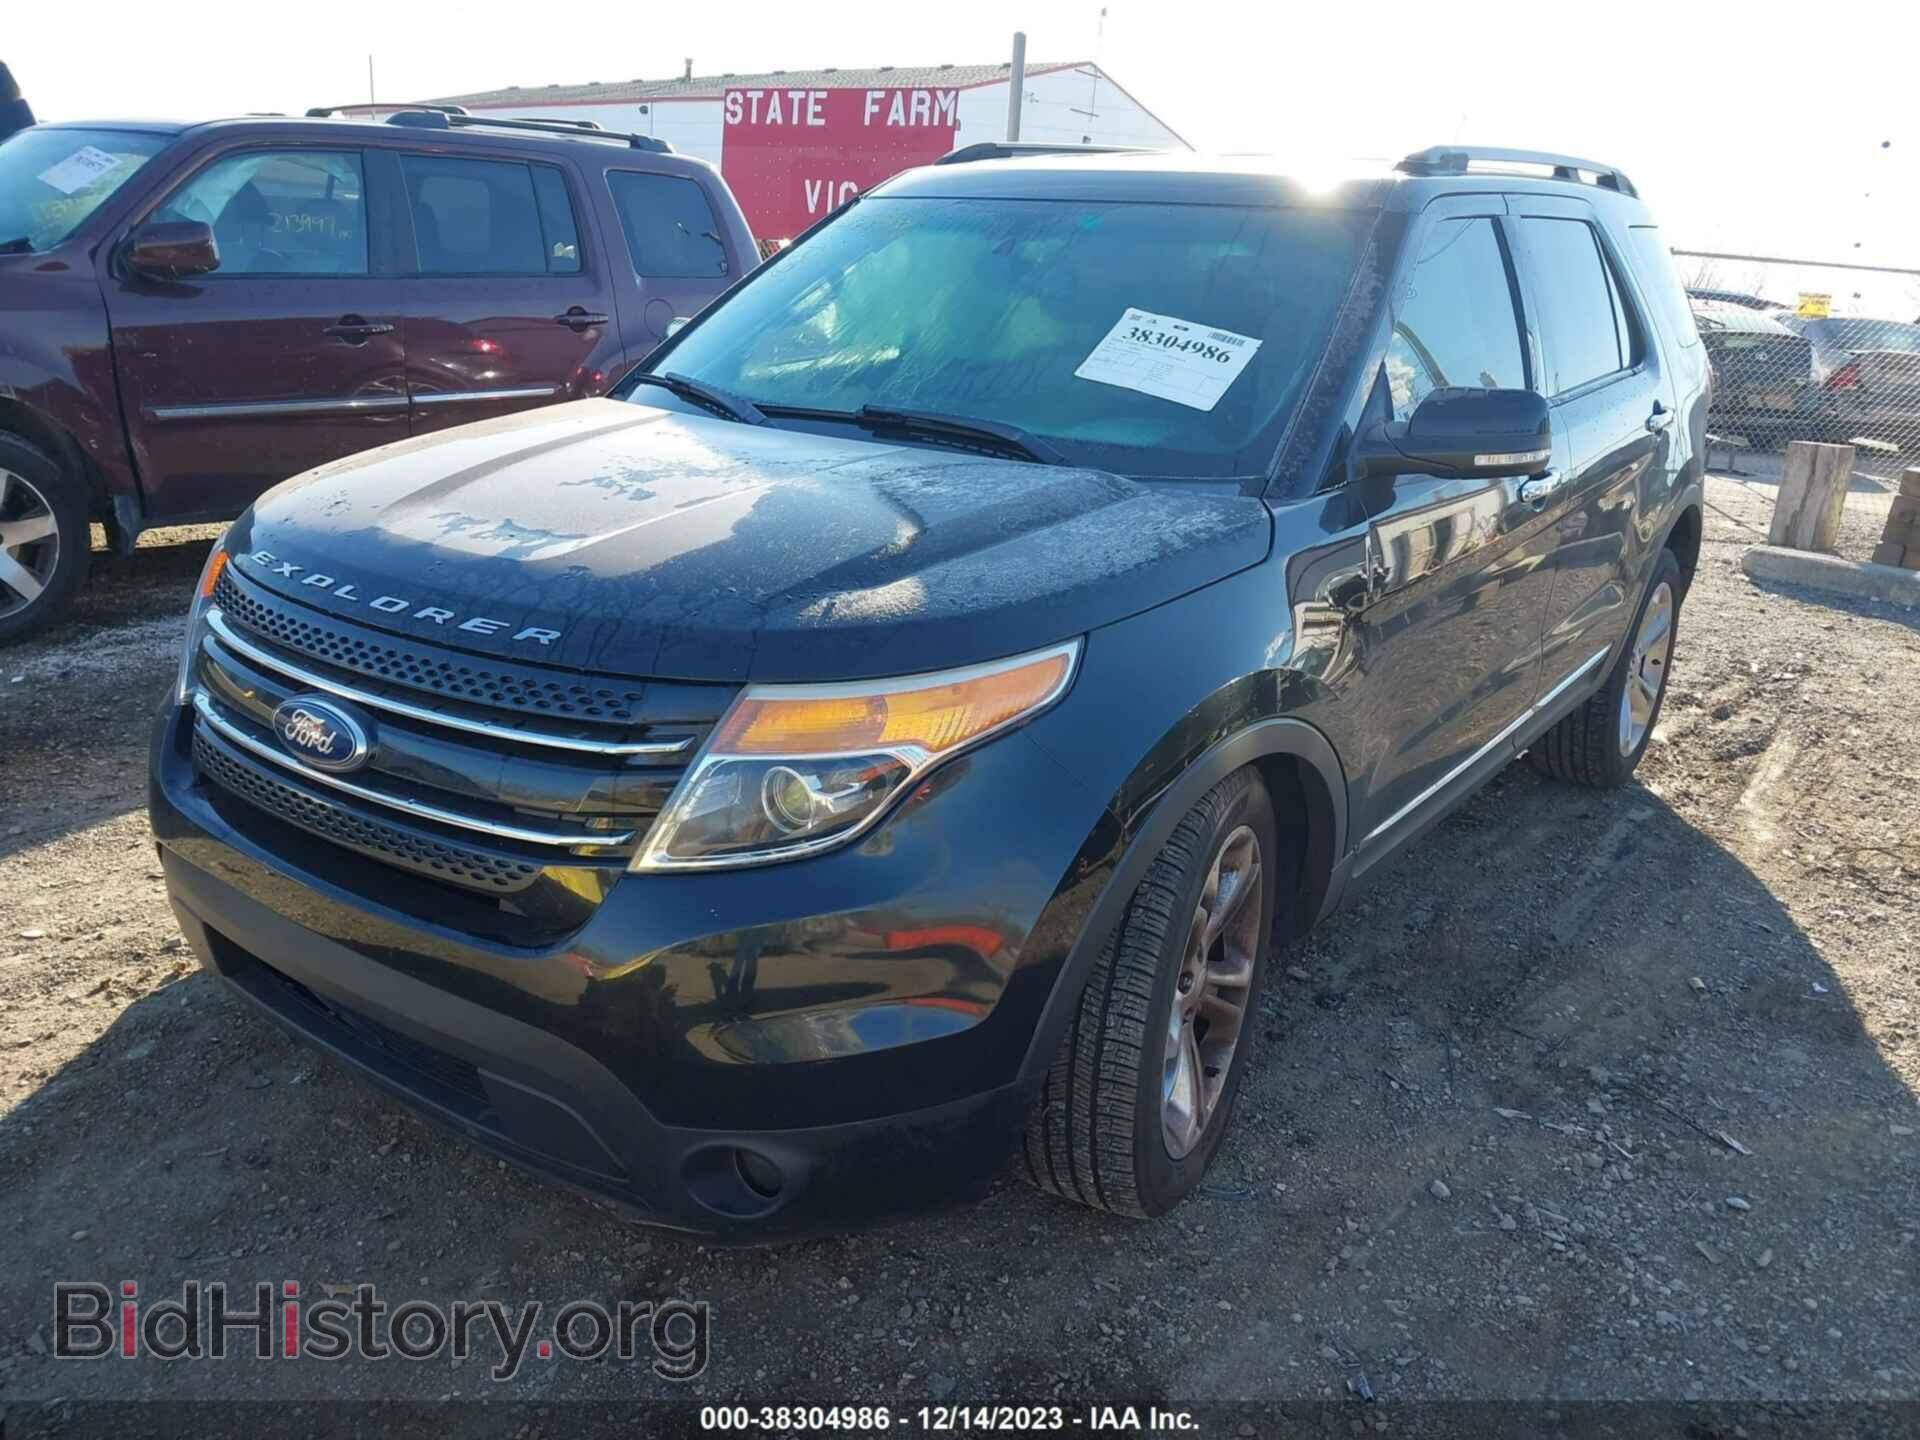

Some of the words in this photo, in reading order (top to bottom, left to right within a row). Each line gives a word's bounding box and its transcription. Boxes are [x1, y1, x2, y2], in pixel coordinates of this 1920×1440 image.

[725, 90, 828, 126] STATE
[863, 90, 957, 127] FARM
[1122, 326, 1231, 364] 38304986
[250, 550, 562, 645] EXPLORER
[284, 708, 337, 754] Ford
